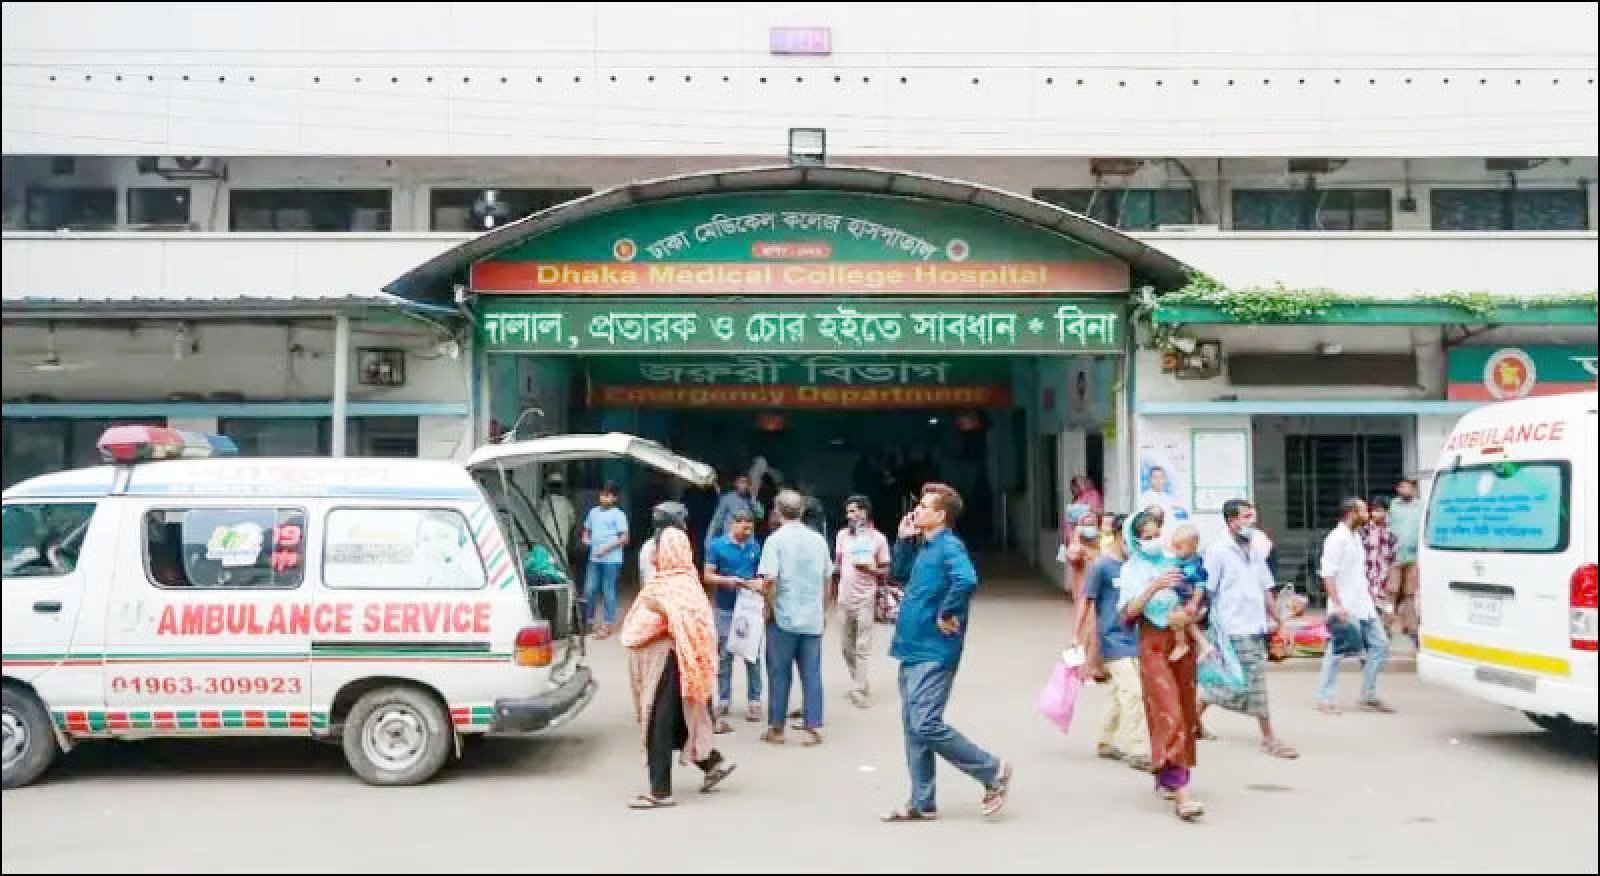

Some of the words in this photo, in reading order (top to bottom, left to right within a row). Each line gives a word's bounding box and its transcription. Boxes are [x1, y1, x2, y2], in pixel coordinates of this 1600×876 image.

[536, 264, 638, 284] Dhaka
[649, 264, 771, 284] Medical
[782, 264, 904, 287] College
[914, 264, 1048, 287] Hospital
[589, 311, 697, 345] প্রতারক
[709, 315, 734, 341] ও
[746, 312, 806, 344] চোর
[814, 305, 903, 346] হইতে
[910, 312, 1017, 345] সাবধান
[1054, 305, 1118, 347] বিনা
[604, 386, 784, 406] Emergency
[796, 386, 985, 406] Department
[157, 601, 352, 636] AMBULANCE
[362, 600, 491, 634] SERVICE
[112, 676, 302, 695] 01963-309923
